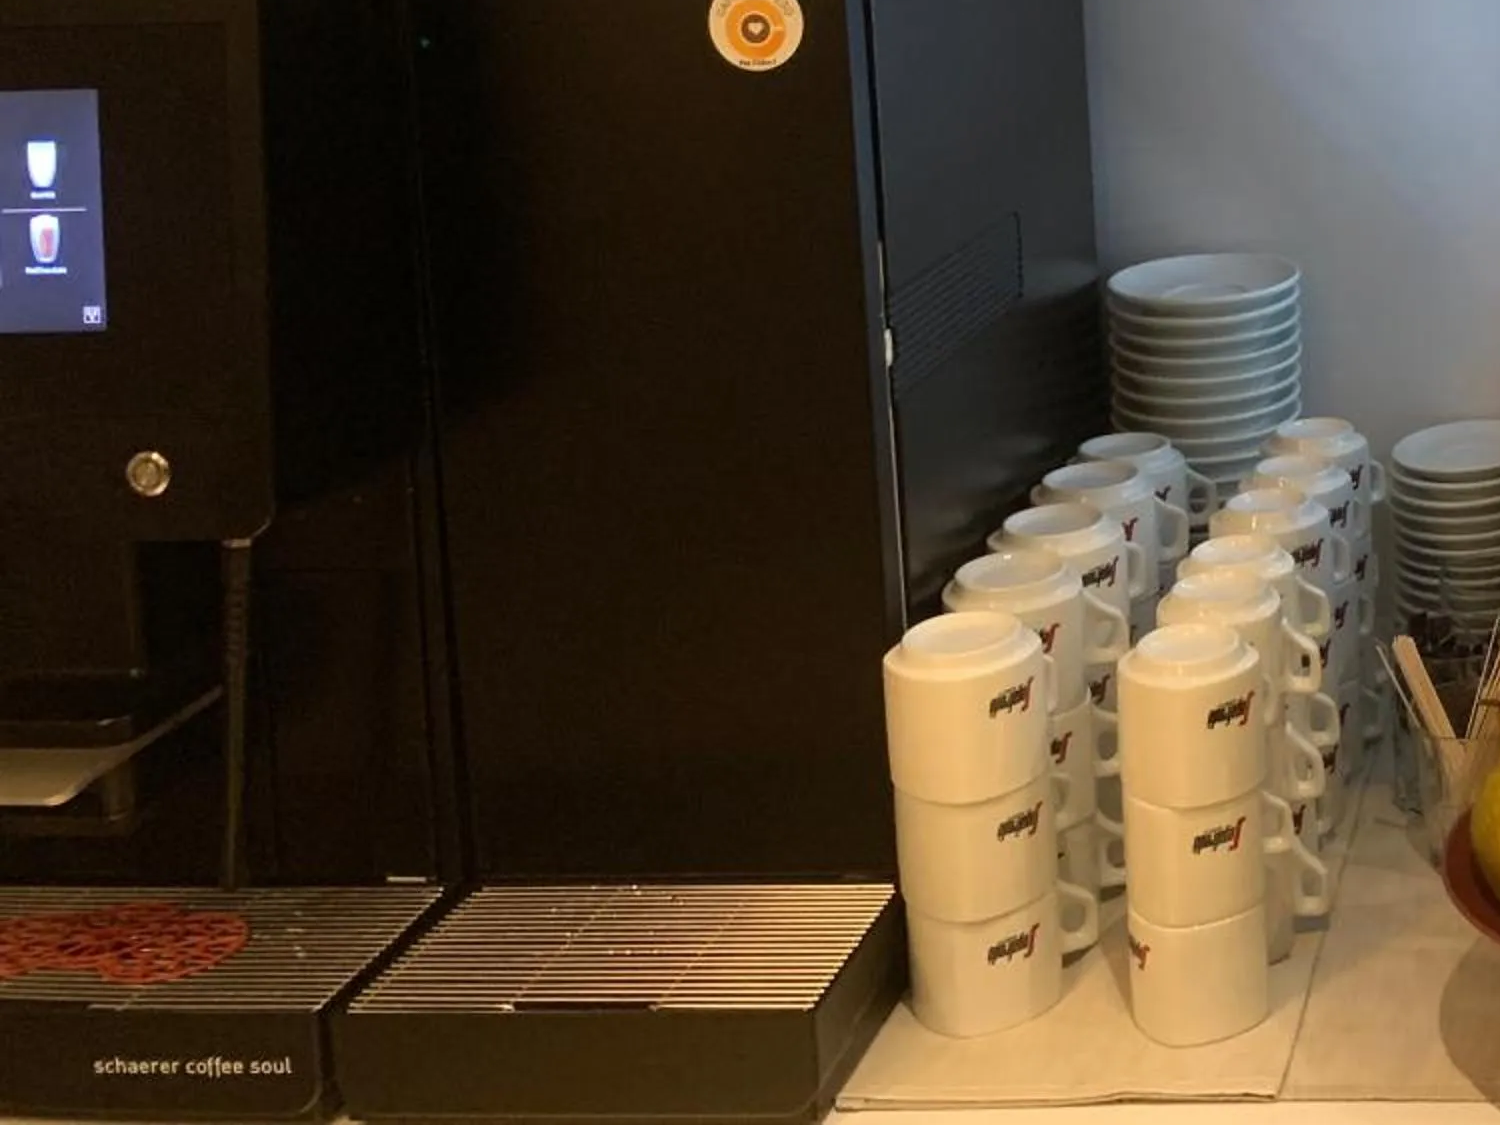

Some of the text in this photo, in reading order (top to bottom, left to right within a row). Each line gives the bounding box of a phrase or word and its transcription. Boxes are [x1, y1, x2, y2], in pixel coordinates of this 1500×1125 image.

[93, 1056, 292, 1079] schaerer coffee soul
